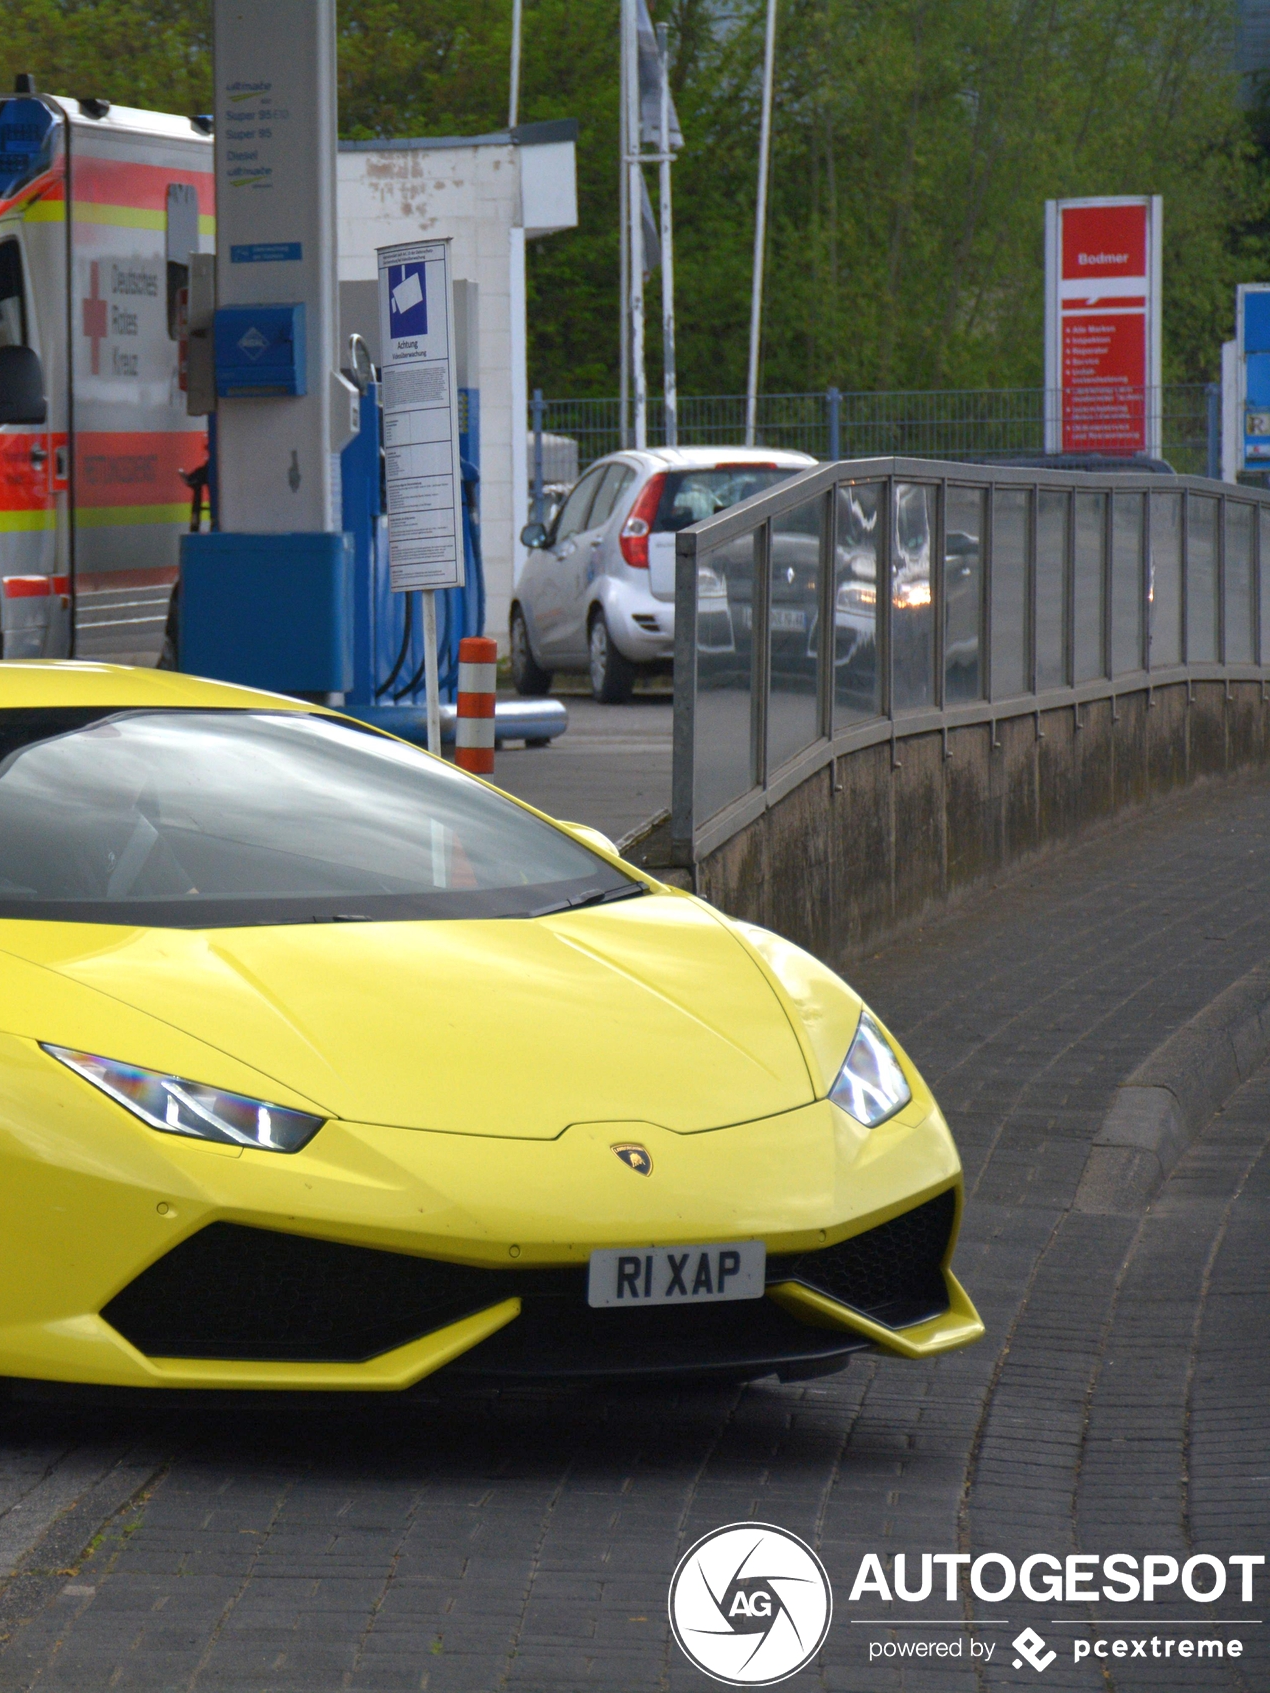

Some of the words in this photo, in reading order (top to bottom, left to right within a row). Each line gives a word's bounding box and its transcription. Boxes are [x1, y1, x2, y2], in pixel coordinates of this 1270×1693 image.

[1078, 251, 1129, 266] Bodmer
[397, 340, 419, 351] Achtung
[665, 1251, 741, 1296] XAP
